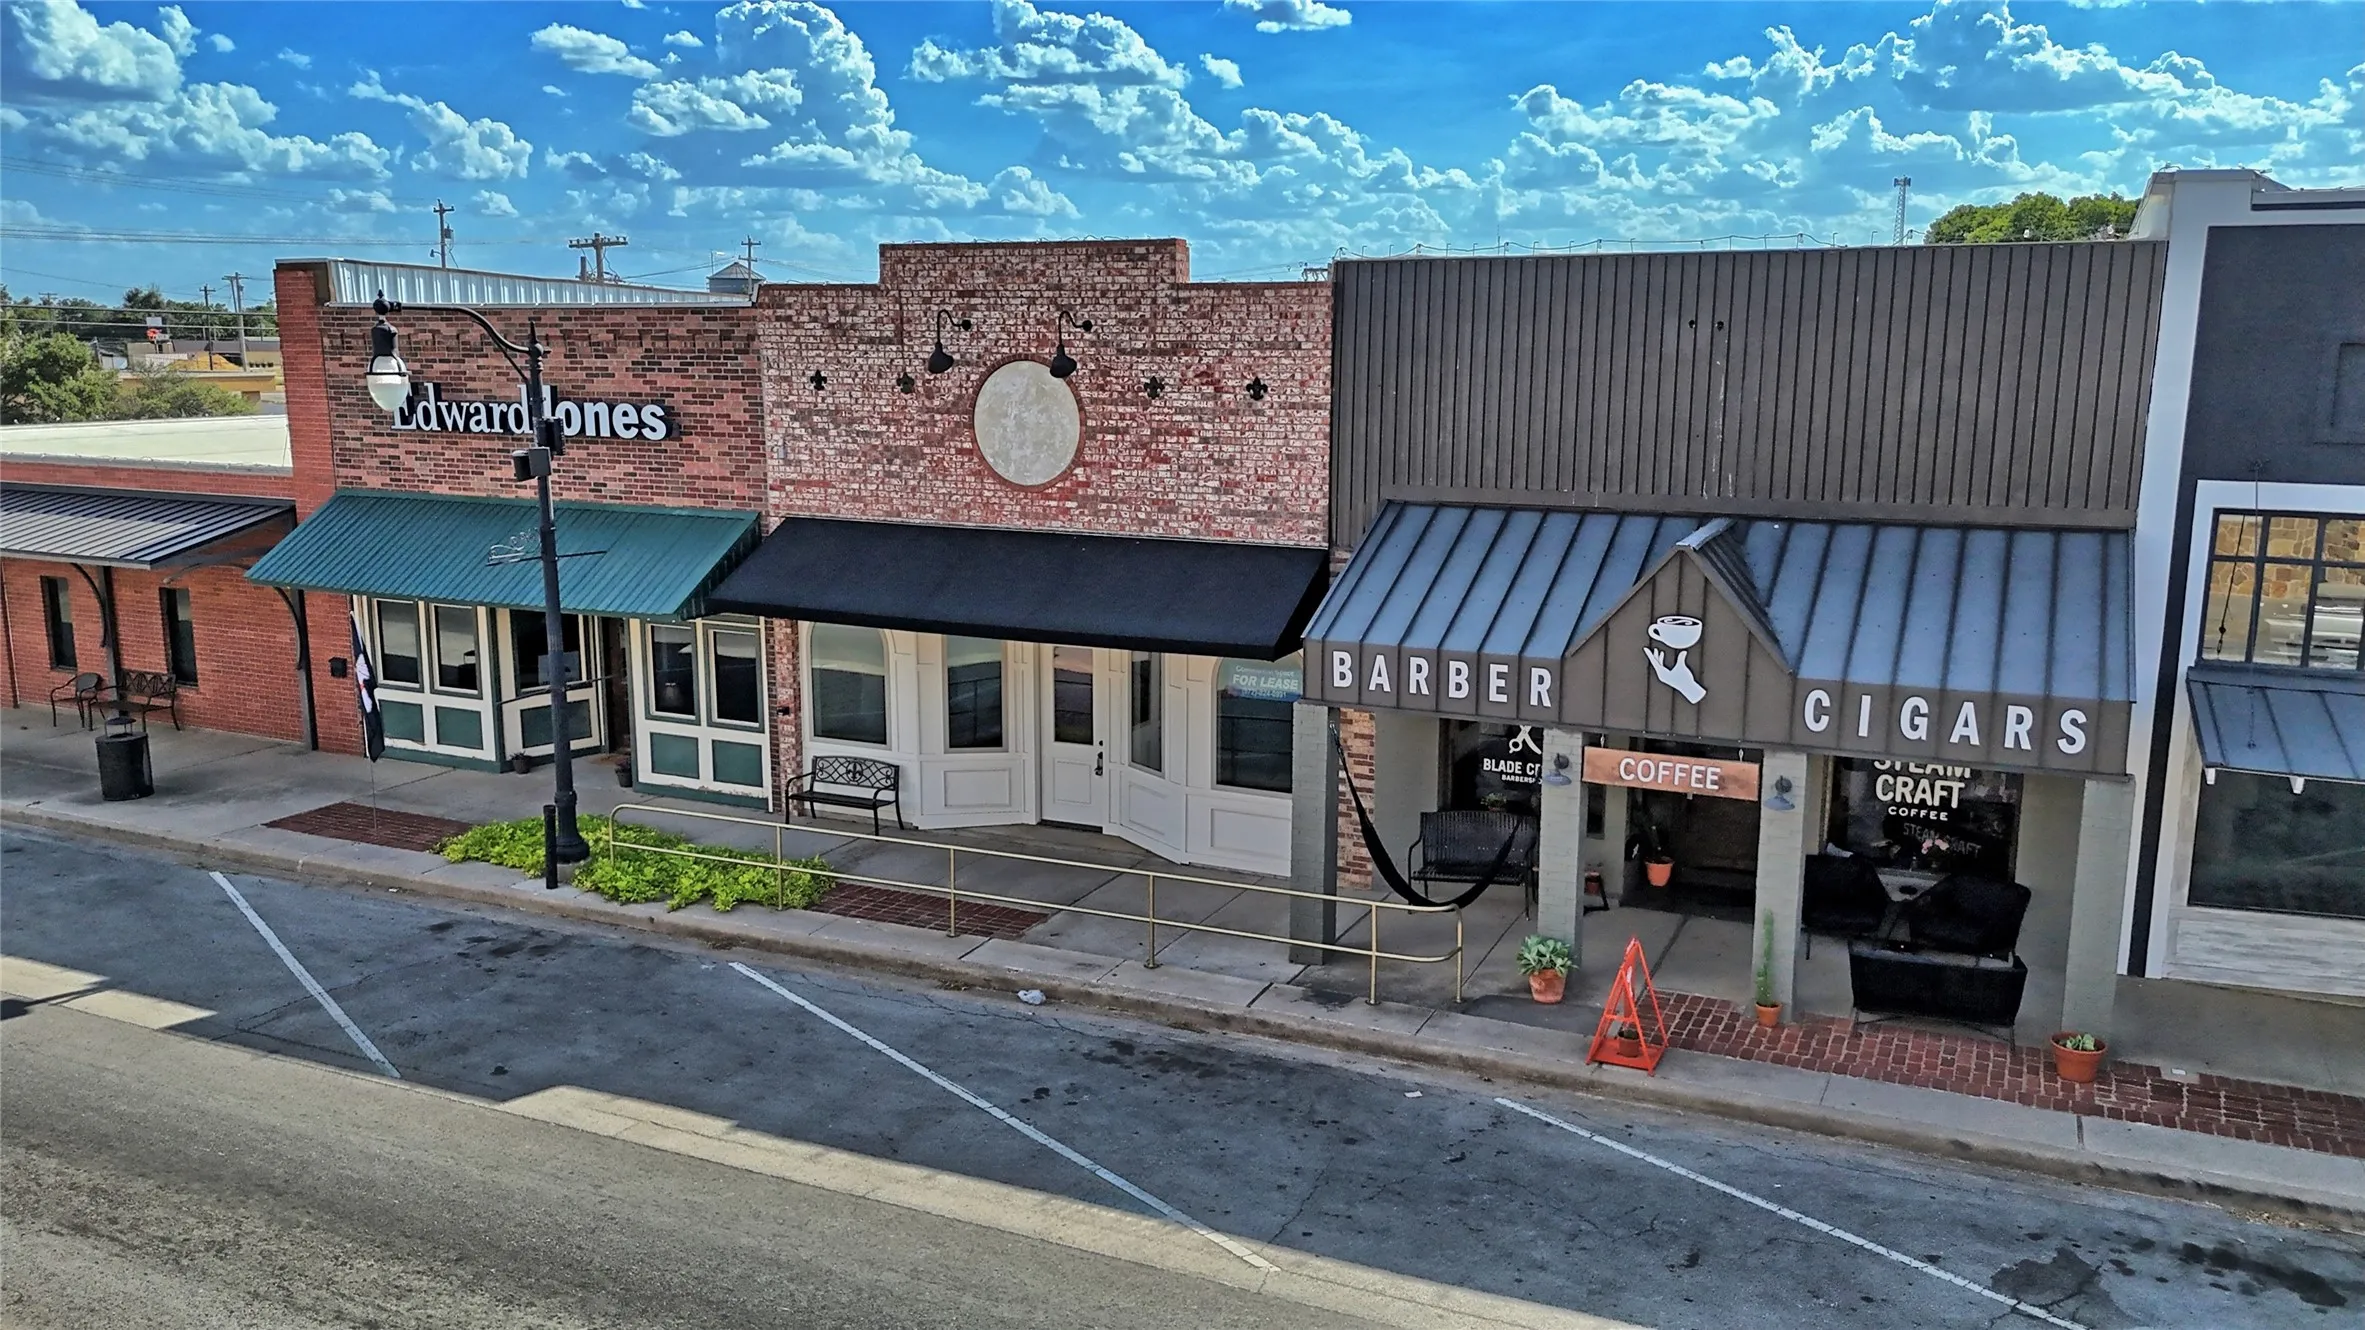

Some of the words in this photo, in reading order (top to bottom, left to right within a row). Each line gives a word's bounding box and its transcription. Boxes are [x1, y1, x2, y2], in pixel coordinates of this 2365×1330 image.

[1232, 673, 1258, 687] FOR
[1260, 676, 1298, 690] LEASE
[1332, 651, 1551, 707] BARBER
[1804, 689, 2087, 754] CIGARS
[1483, 758, 1522, 774] BLADE
[1619, 757, 1721, 790] COFFEE
[1876, 774, 1965, 808] CRAFT
[1888, 806, 1948, 821] COFFEE
